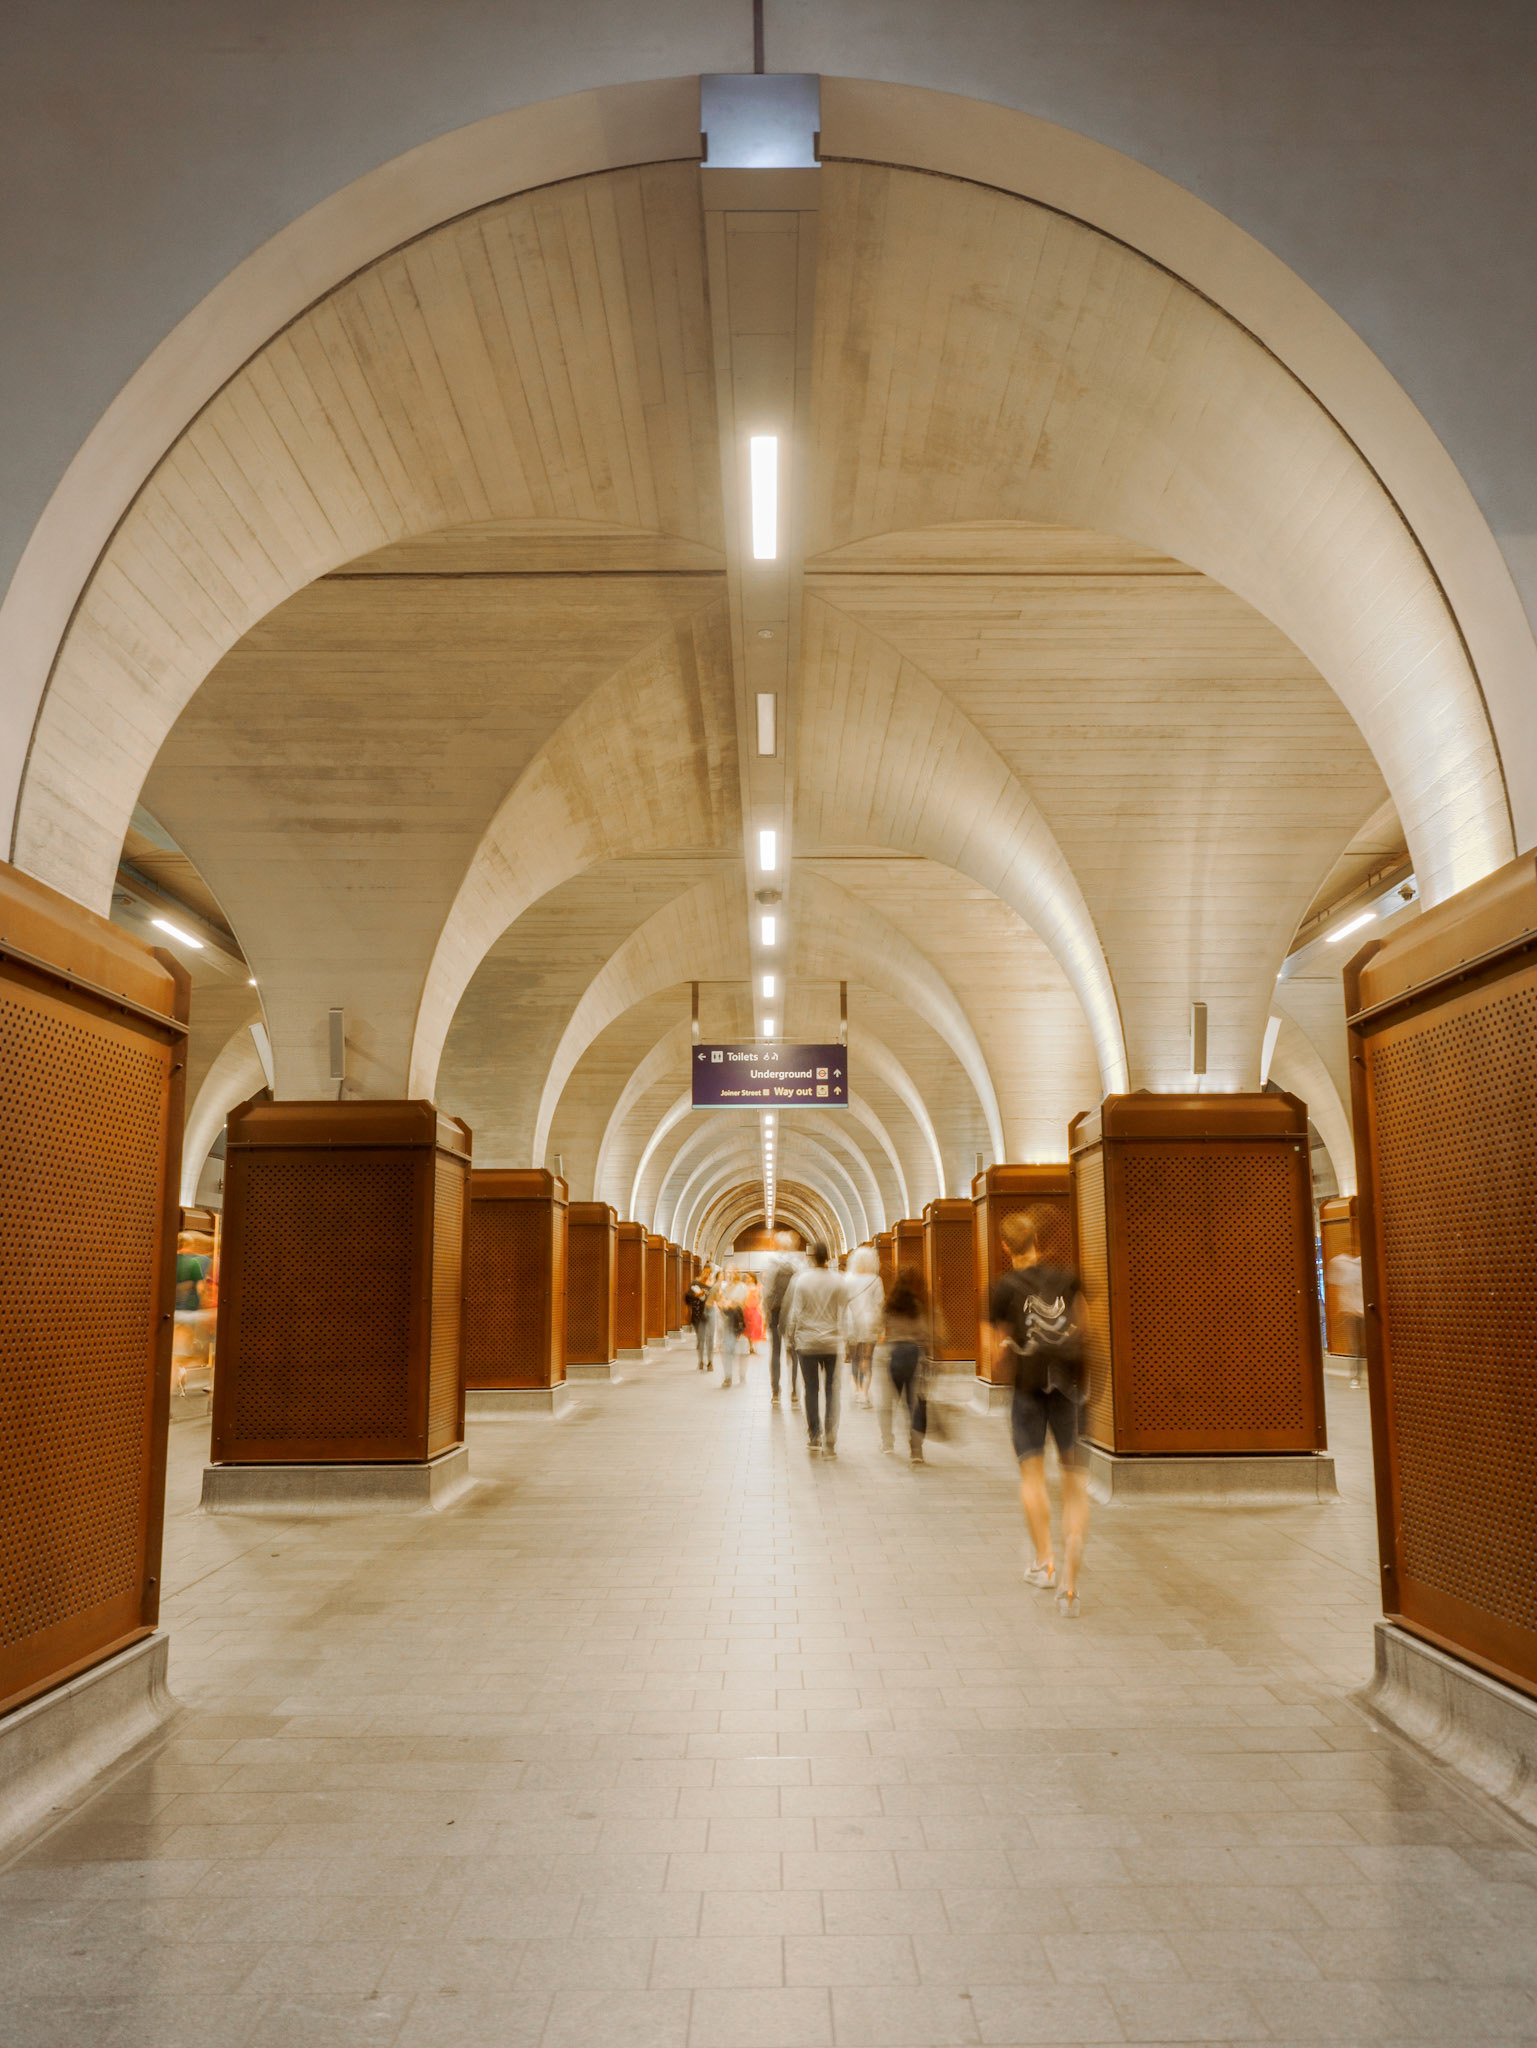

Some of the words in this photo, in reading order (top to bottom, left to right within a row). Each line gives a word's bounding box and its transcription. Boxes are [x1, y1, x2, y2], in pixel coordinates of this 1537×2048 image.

[727, 1052, 758, 1061] Toilets
[750, 1069, 812, 1080] Underground
[720, 1089, 740, 1097] Joiner
[741, 1089, 762, 1097] Street
[774, 1087, 794, 1098] Way
[796, 1087, 812, 1096] out
